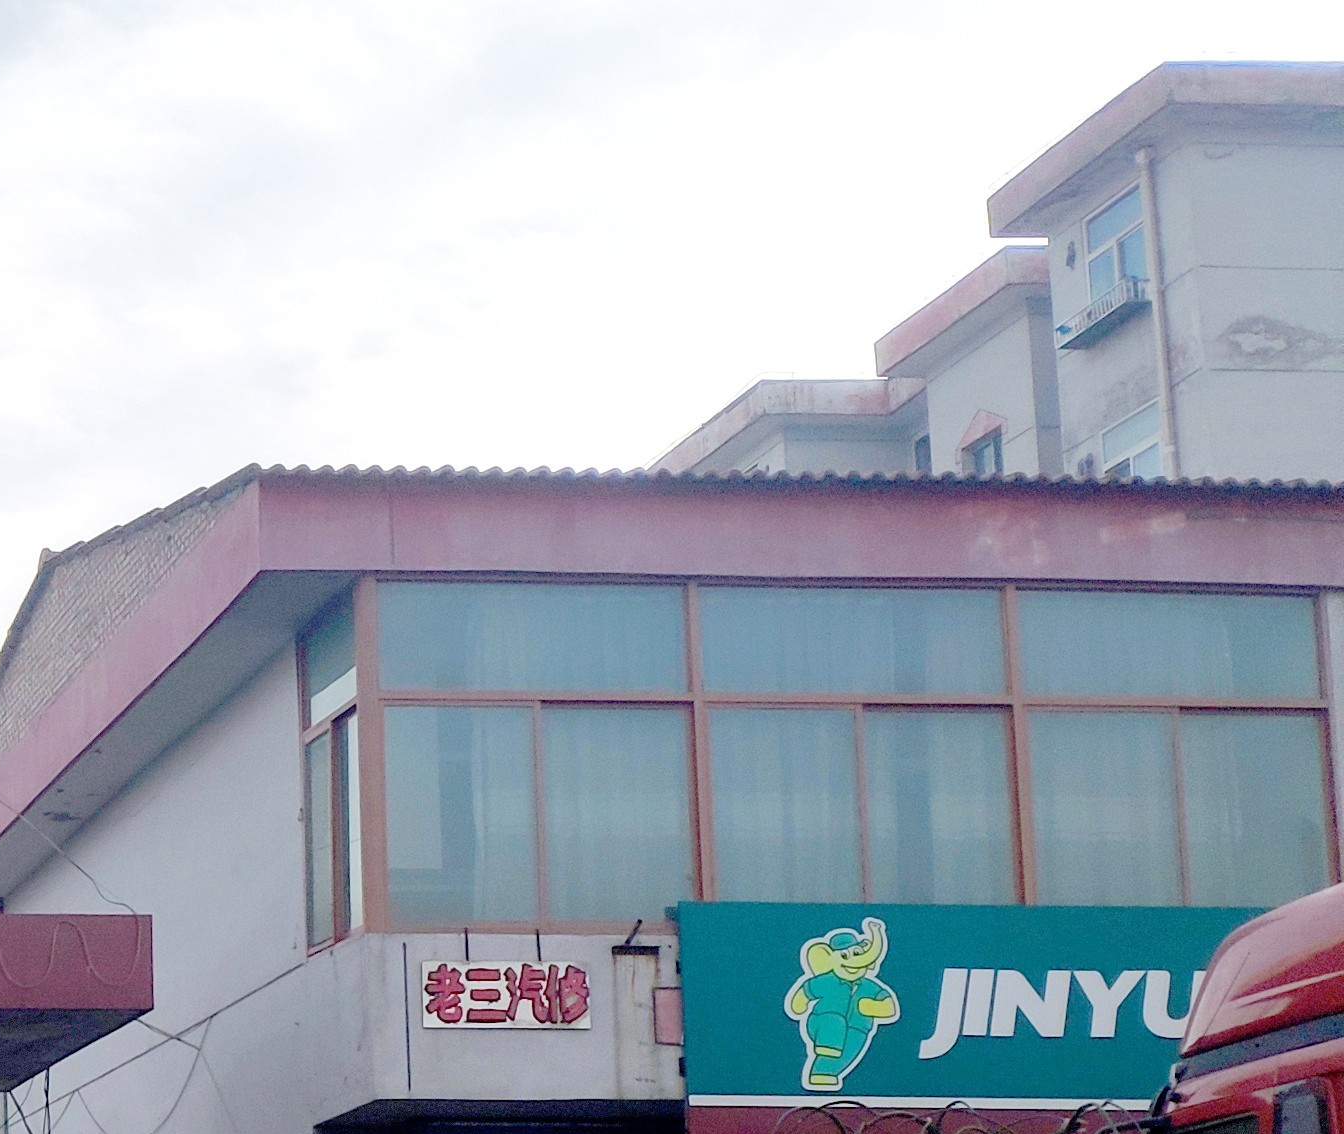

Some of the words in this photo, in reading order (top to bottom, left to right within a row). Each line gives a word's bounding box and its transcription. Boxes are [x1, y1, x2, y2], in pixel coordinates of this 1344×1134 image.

[424, 963, 591, 1025] 老三汽修
[918, 967, 1210, 1060] JINYU
